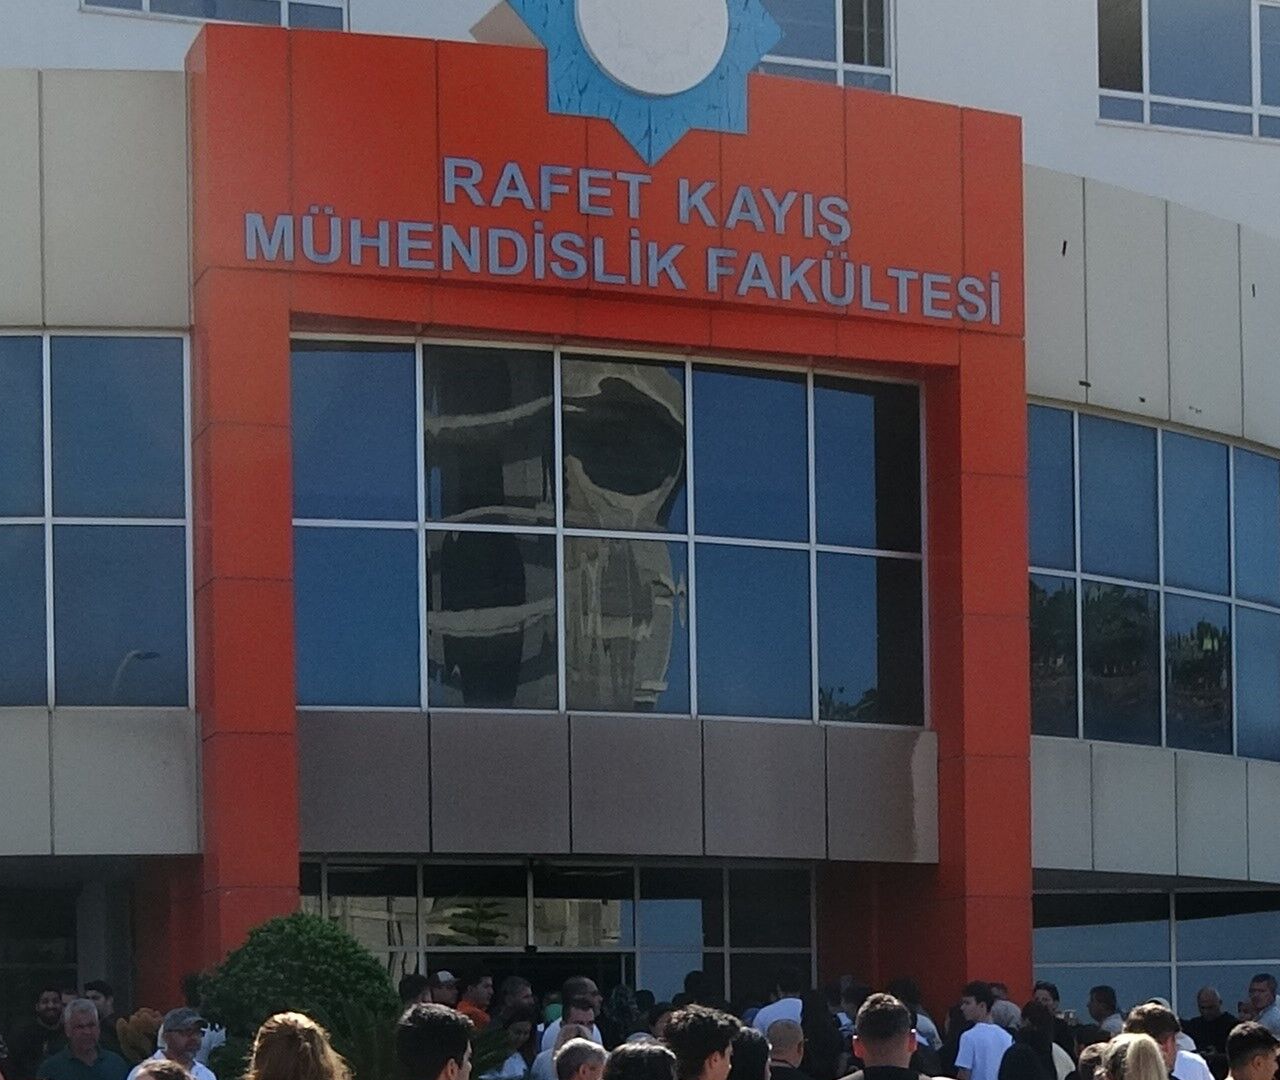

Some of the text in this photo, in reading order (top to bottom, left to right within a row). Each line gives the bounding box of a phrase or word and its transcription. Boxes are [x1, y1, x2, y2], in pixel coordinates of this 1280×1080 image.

[444, 158, 852, 247] RAFET KAYIŞ
[245, 205, 1001, 325] MÜHENDİSLİK FAKÜLTESİ
